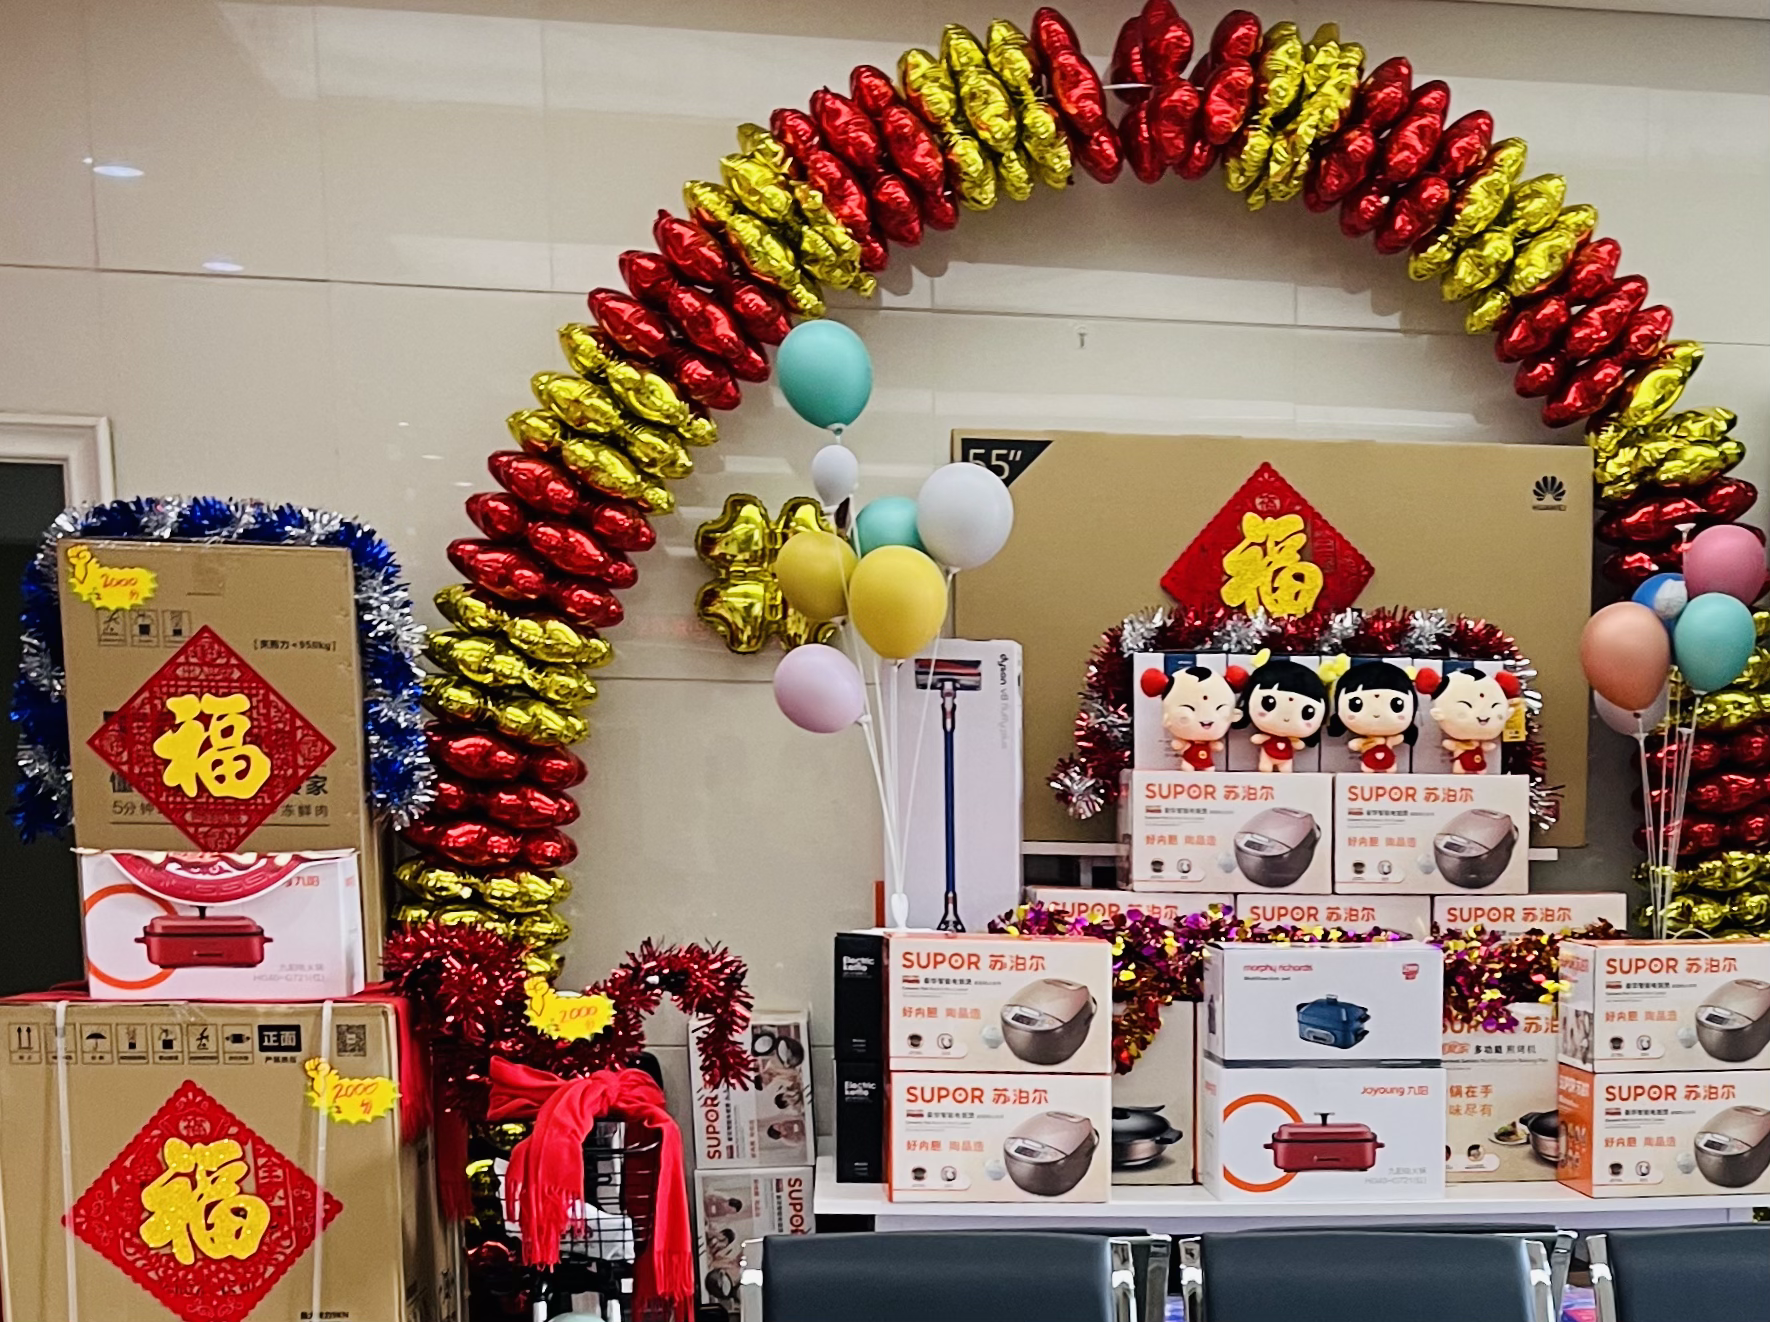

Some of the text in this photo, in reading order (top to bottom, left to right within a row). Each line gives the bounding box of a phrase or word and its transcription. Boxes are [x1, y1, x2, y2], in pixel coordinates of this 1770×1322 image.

[1221, 512, 1324, 618] 福
[153, 692, 272, 799] 福
[1145, 782, 1275, 801] SUPOR 苏泊尔
[1347, 785, 1474, 802] SUPOR 苏泊尔
[1250, 906, 1376, 922] SUPOR 苏泊尔
[1447, 906, 1572, 922] SUPOR 苏泊尔
[902, 951, 1046, 971] SUPOR 苏泊尔
[1605, 957, 1679, 974] SUPOR
[1685, 957, 1738, 973] 苏泊尔
[559, 1005, 598, 1024] 2000
[1524, 1016, 1560, 1033] 苏泊
[262, 1030, 297, 1047] 正面
[333, 1081, 379, 1103] 2000
[906, 1085, 1049, 1104] SUPOR 苏泊尔
[1361, 1086, 1405, 1097] Joyoung
[1604, 1084, 1677, 1102] SUPOR
[1684, 1084, 1736, 1101] 苏泊尔
[704, 1093, 722, 1160] SUPOR
[139, 1137, 271, 1266] 福
